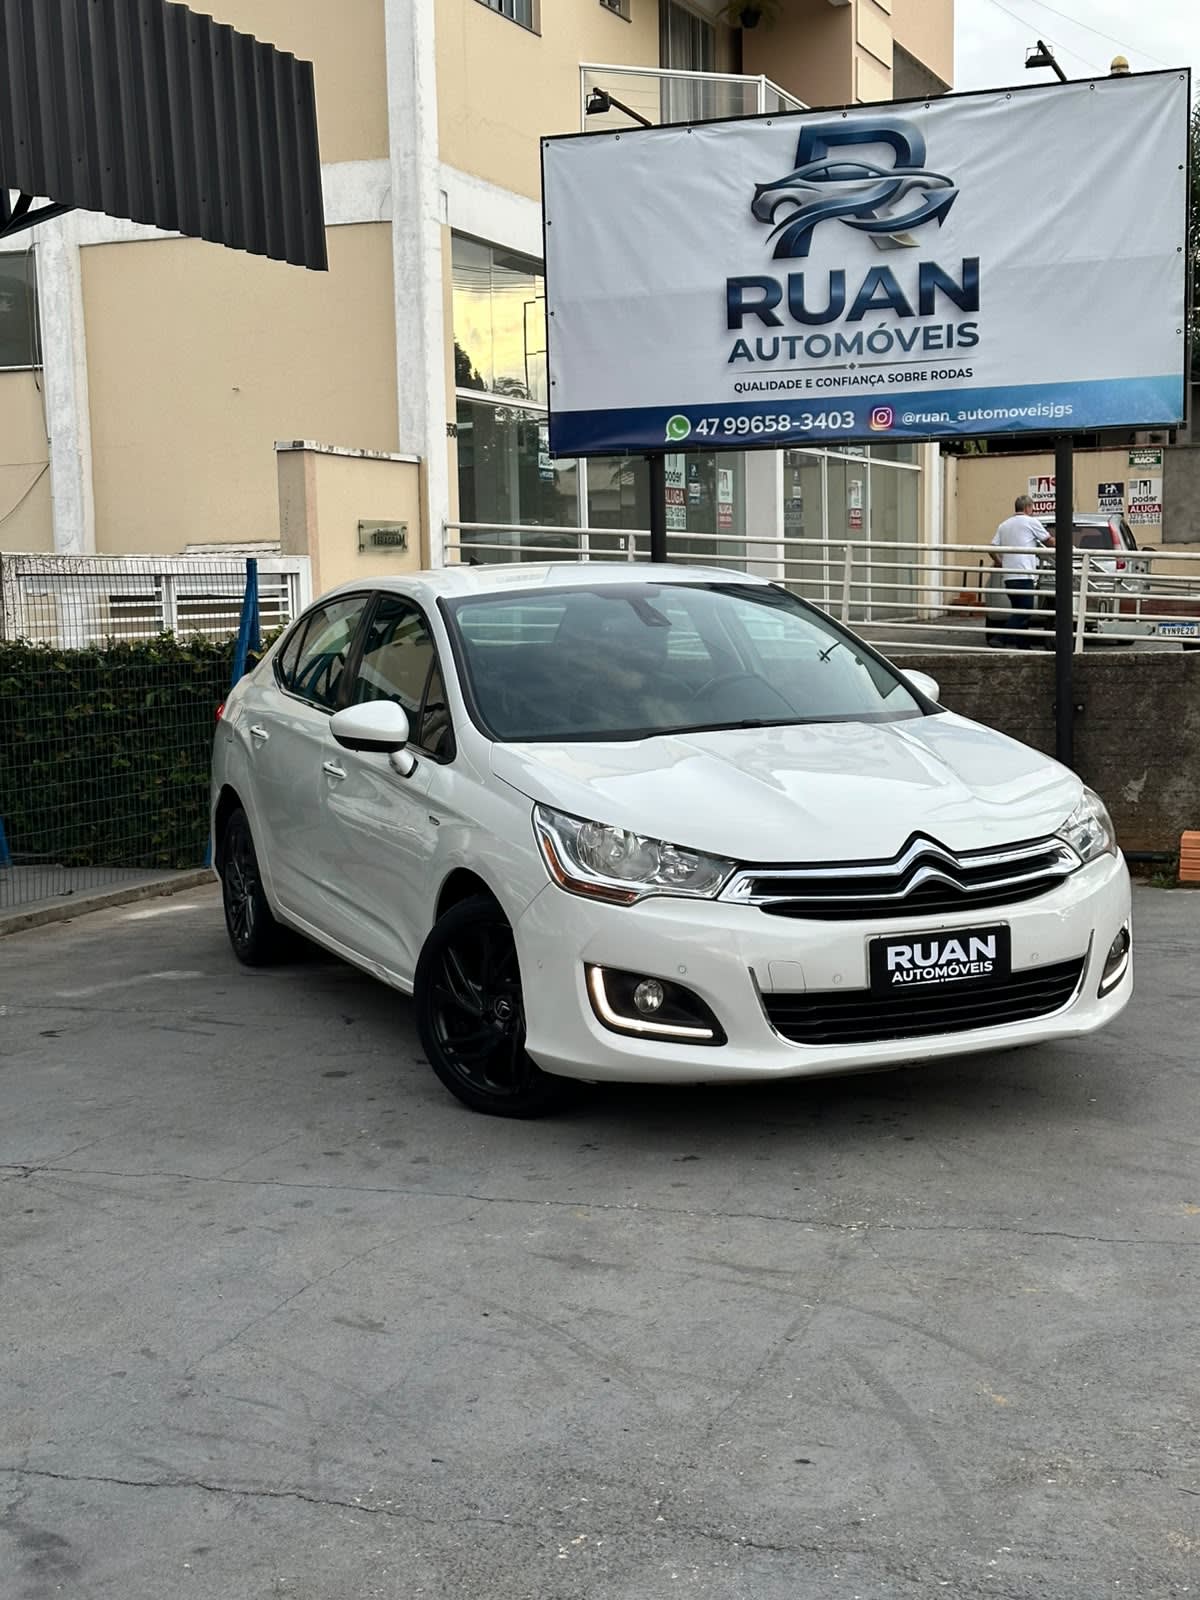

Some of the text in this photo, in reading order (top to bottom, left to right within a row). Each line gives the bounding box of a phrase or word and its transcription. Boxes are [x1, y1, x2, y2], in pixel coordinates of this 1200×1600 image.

[727, 257, 980, 330] RUAN
[727, 322, 980, 363] AUTOMÓVEIS
[734, 368, 973, 393] QUALIDADE E CONFIANÇA SOBRE RODAS
[695, 411, 855, 436] 47 99658-3403
[902, 402, 1073, 427] @ruan_automoveisjgs
[1100, 498, 1122, 506] ALUGA
[1130, 505, 1160, 513] ALUGA
[887, 935, 996, 970] RUAN
[892, 961, 993, 983] AUTOMÓVEIS
